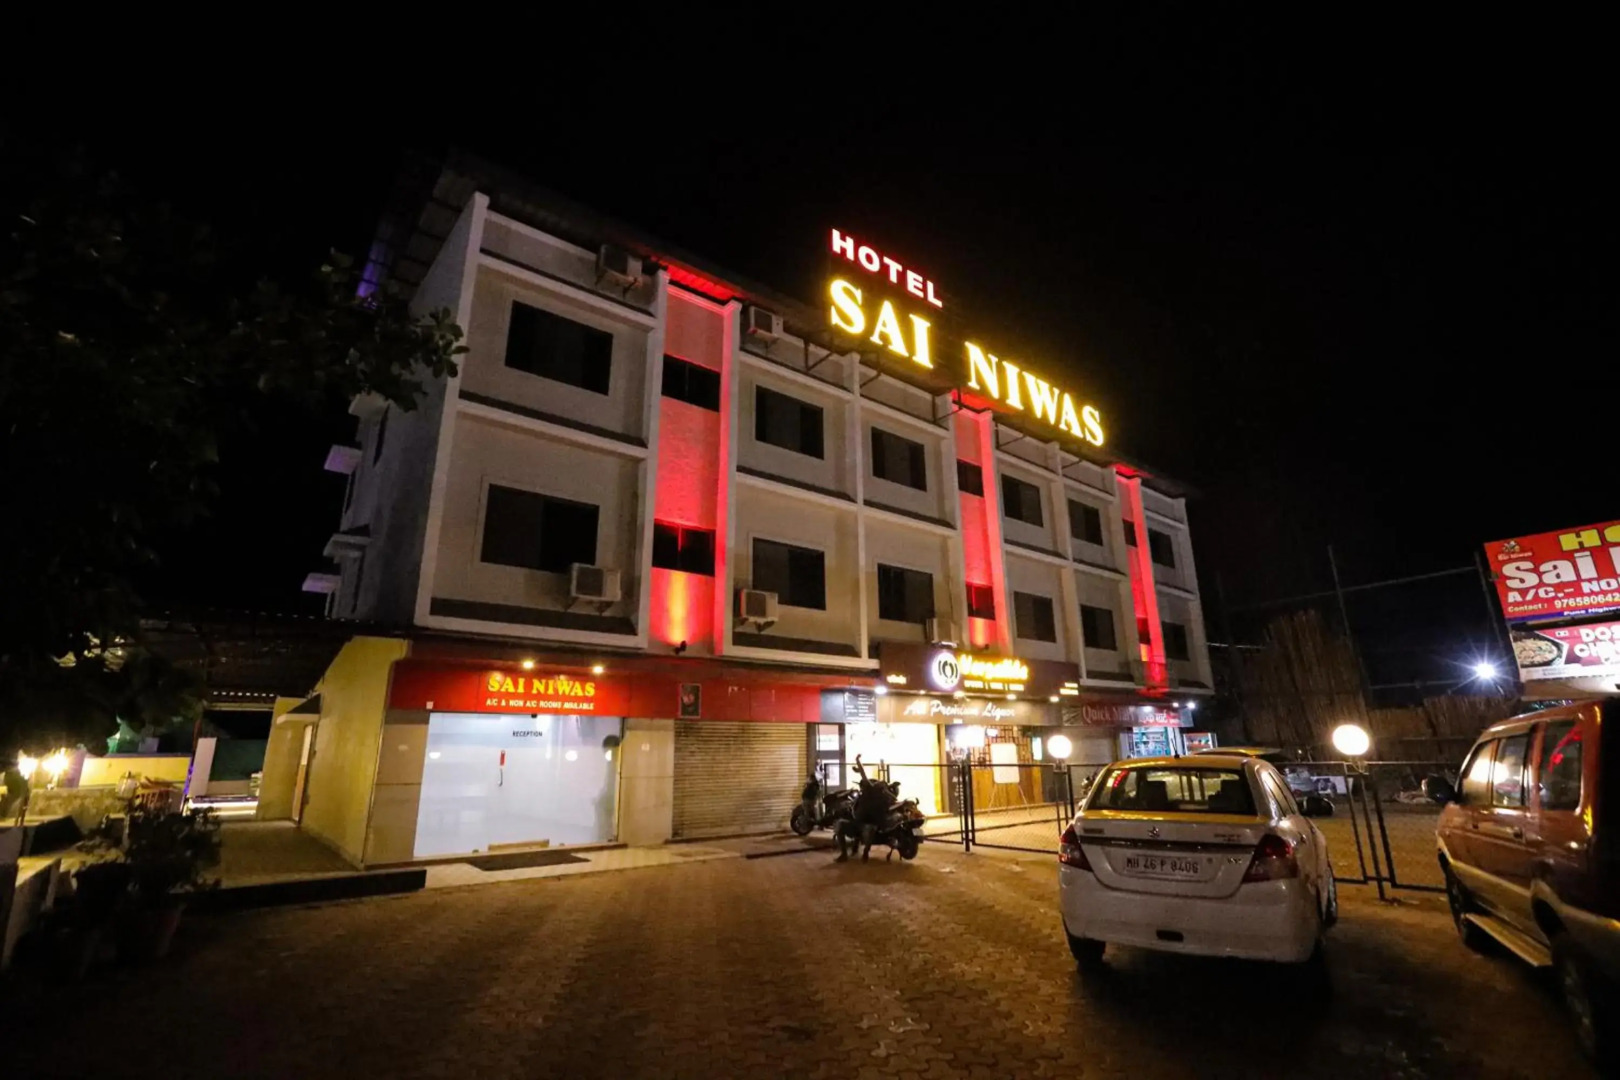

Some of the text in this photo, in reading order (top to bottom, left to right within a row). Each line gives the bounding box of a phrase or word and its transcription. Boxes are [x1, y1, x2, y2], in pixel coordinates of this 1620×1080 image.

[831, 228, 943, 308] HOTEL
[830, 278, 1105, 447] SAI NIWAS
[1502, 551, 1598, 589] Sai
[488, 674, 596, 697] SAI NIWAS
[512, 730, 543, 738] RECEPTION
